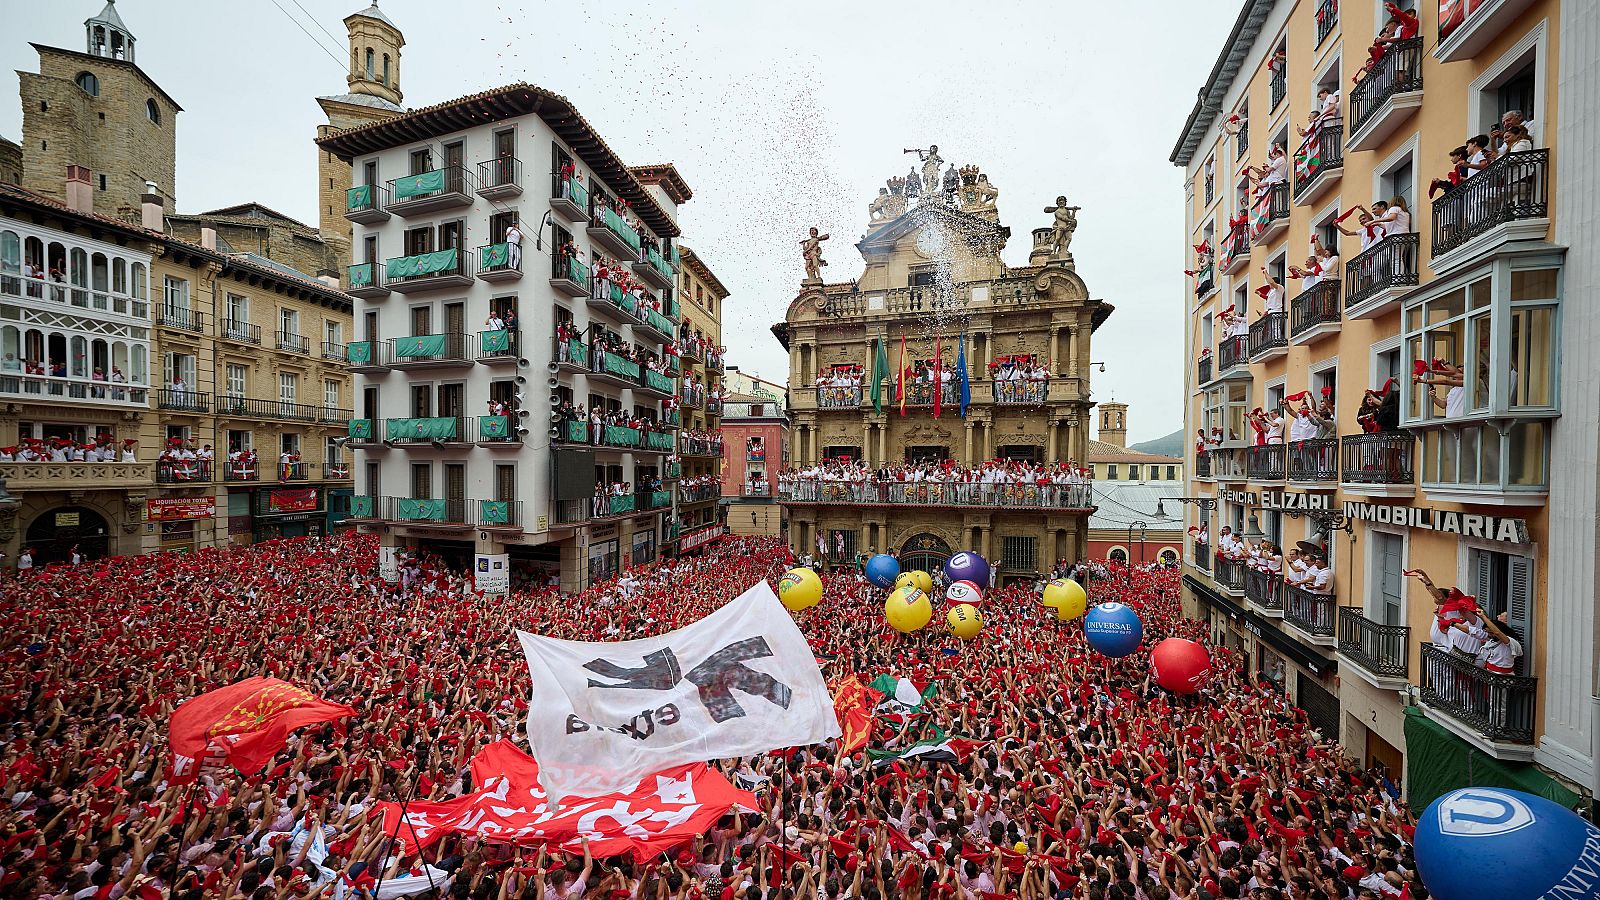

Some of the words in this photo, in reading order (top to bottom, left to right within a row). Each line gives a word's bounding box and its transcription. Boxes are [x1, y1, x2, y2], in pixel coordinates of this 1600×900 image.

[1217, 488, 1254, 505] AGENCIA
[1261, 490, 1328, 510] ELIZARI
[1343, 501, 1520, 544] INMOBILIARIA
[1087, 621, 1132, 631] UNIVERSAE
[1371, 710, 1377, 722] 2
[1450, 792, 1515, 824] U
